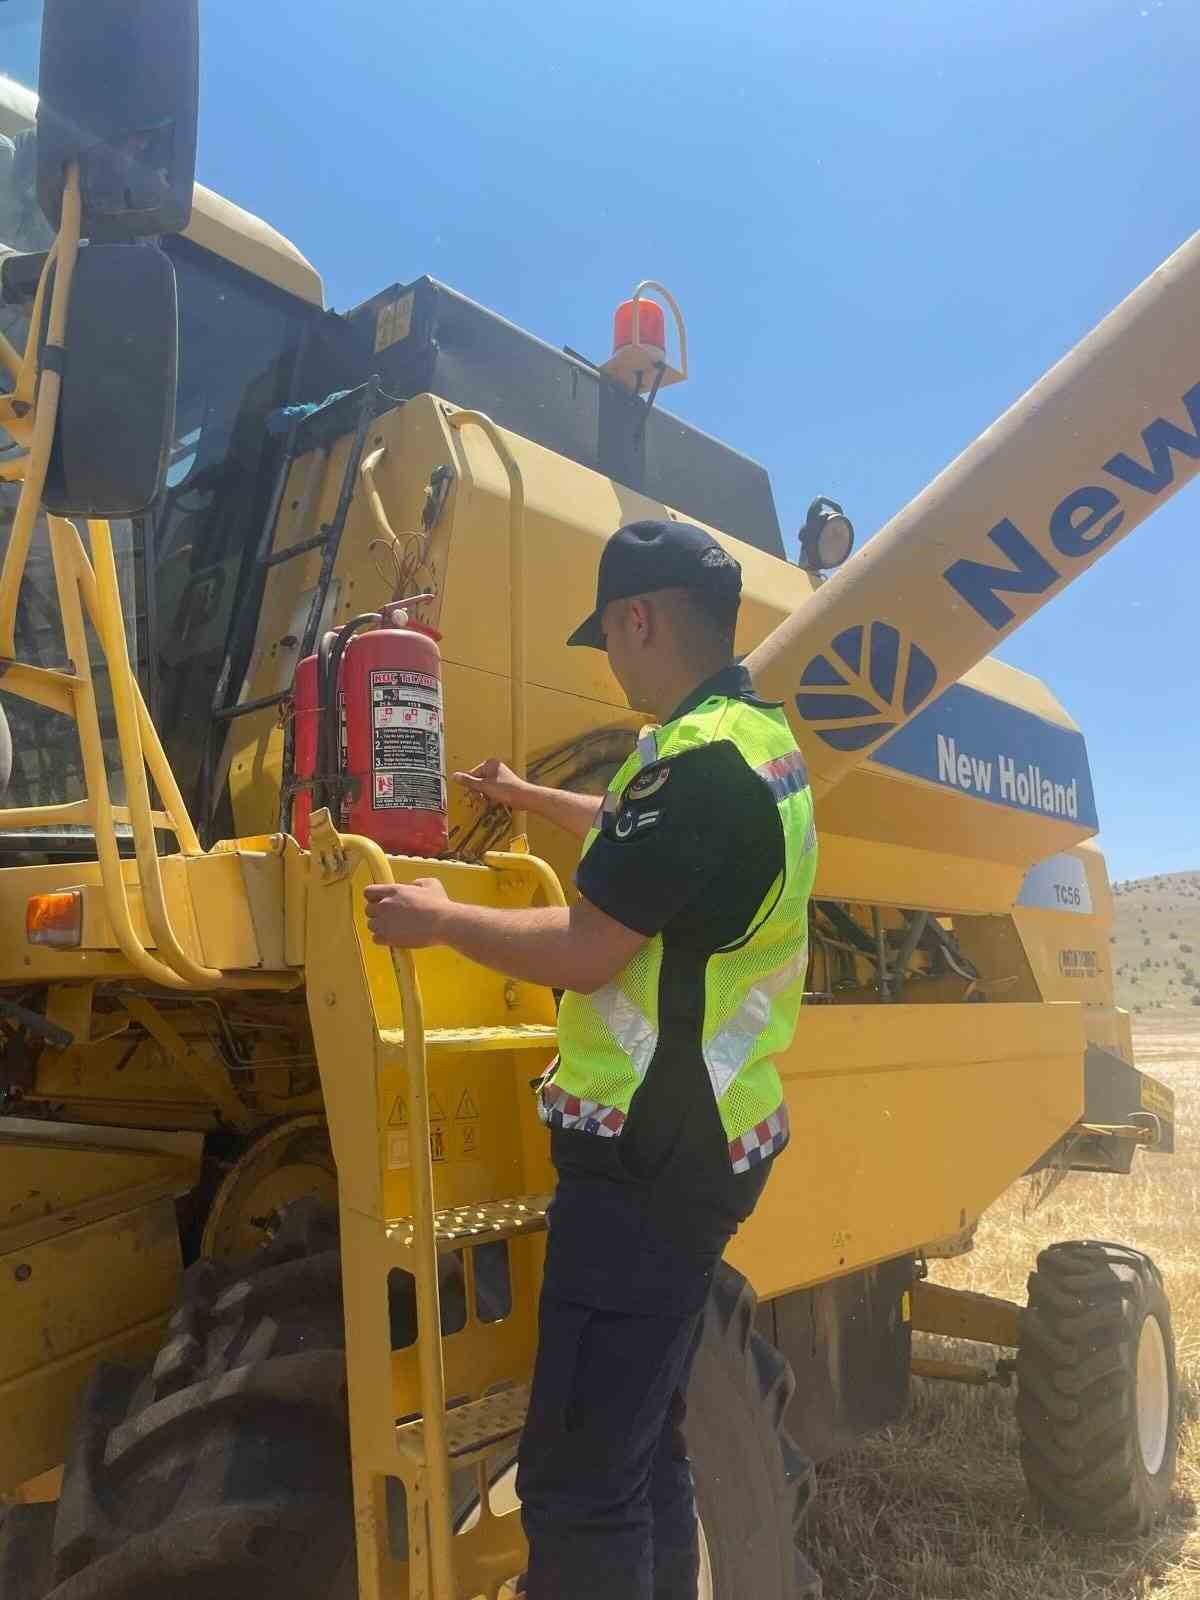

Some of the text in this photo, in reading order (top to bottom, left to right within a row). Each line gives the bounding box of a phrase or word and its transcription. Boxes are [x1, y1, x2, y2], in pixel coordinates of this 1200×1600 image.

[942, 381, 1200, 631] New
[937, 734, 1078, 819] New Holland
[1053, 884, 1081, 905] TC56
